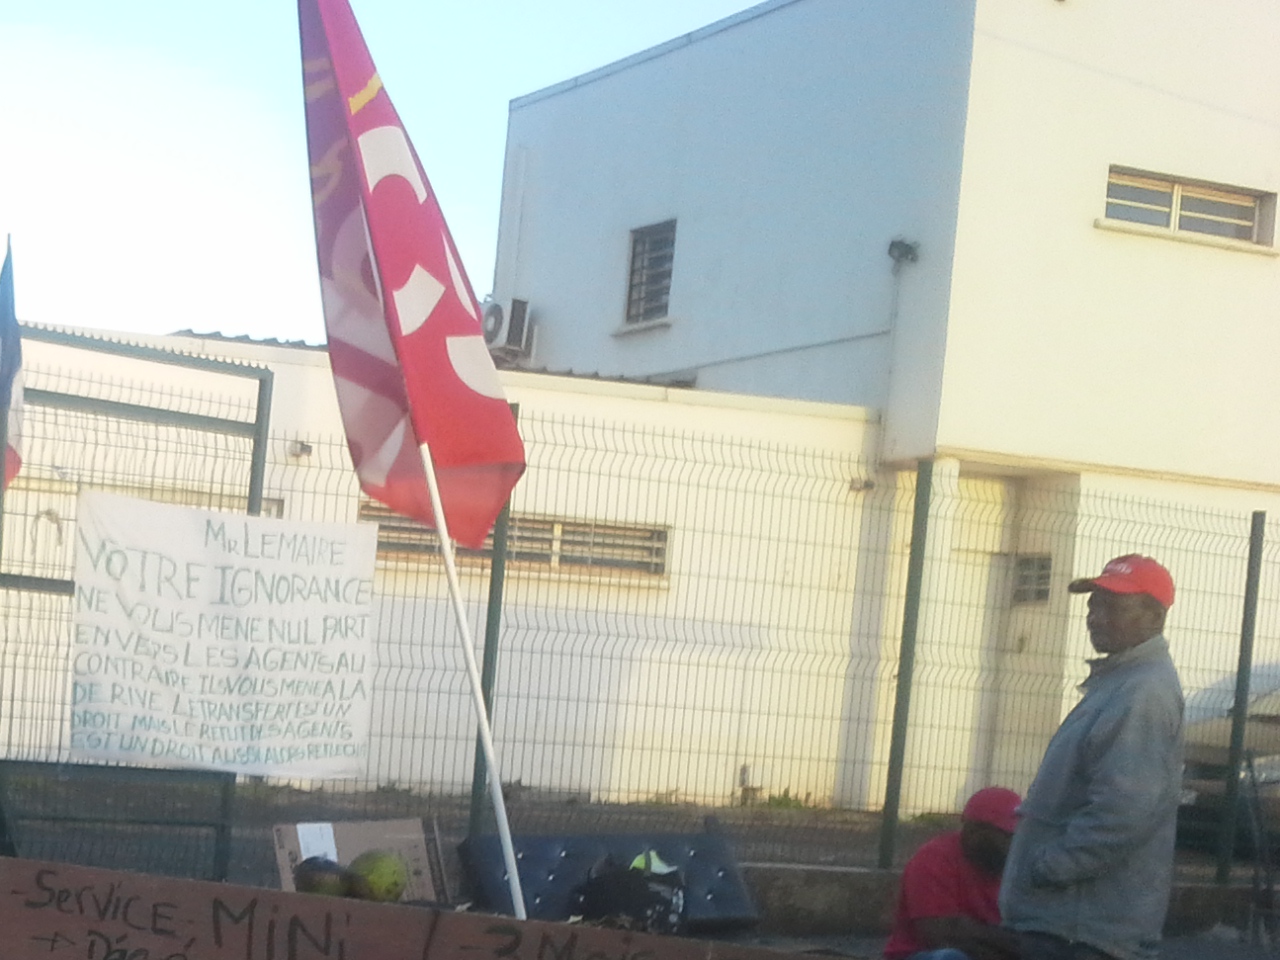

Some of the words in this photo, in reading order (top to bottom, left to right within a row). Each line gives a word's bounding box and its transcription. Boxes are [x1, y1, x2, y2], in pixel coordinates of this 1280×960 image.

[78, 526, 207, 601] VOTRE
[209, 564, 374, 608] IGNORANCE
[244, 521, 346, 567] LEMAIRE
[76, 585, 109, 615] NE
[115, 592, 194, 638] VOUS
[197, 611, 264, 644] MENE
[268, 616, 317, 646] NUL
[321, 613, 371, 646] PART
[183, 641, 239, 669] LES
